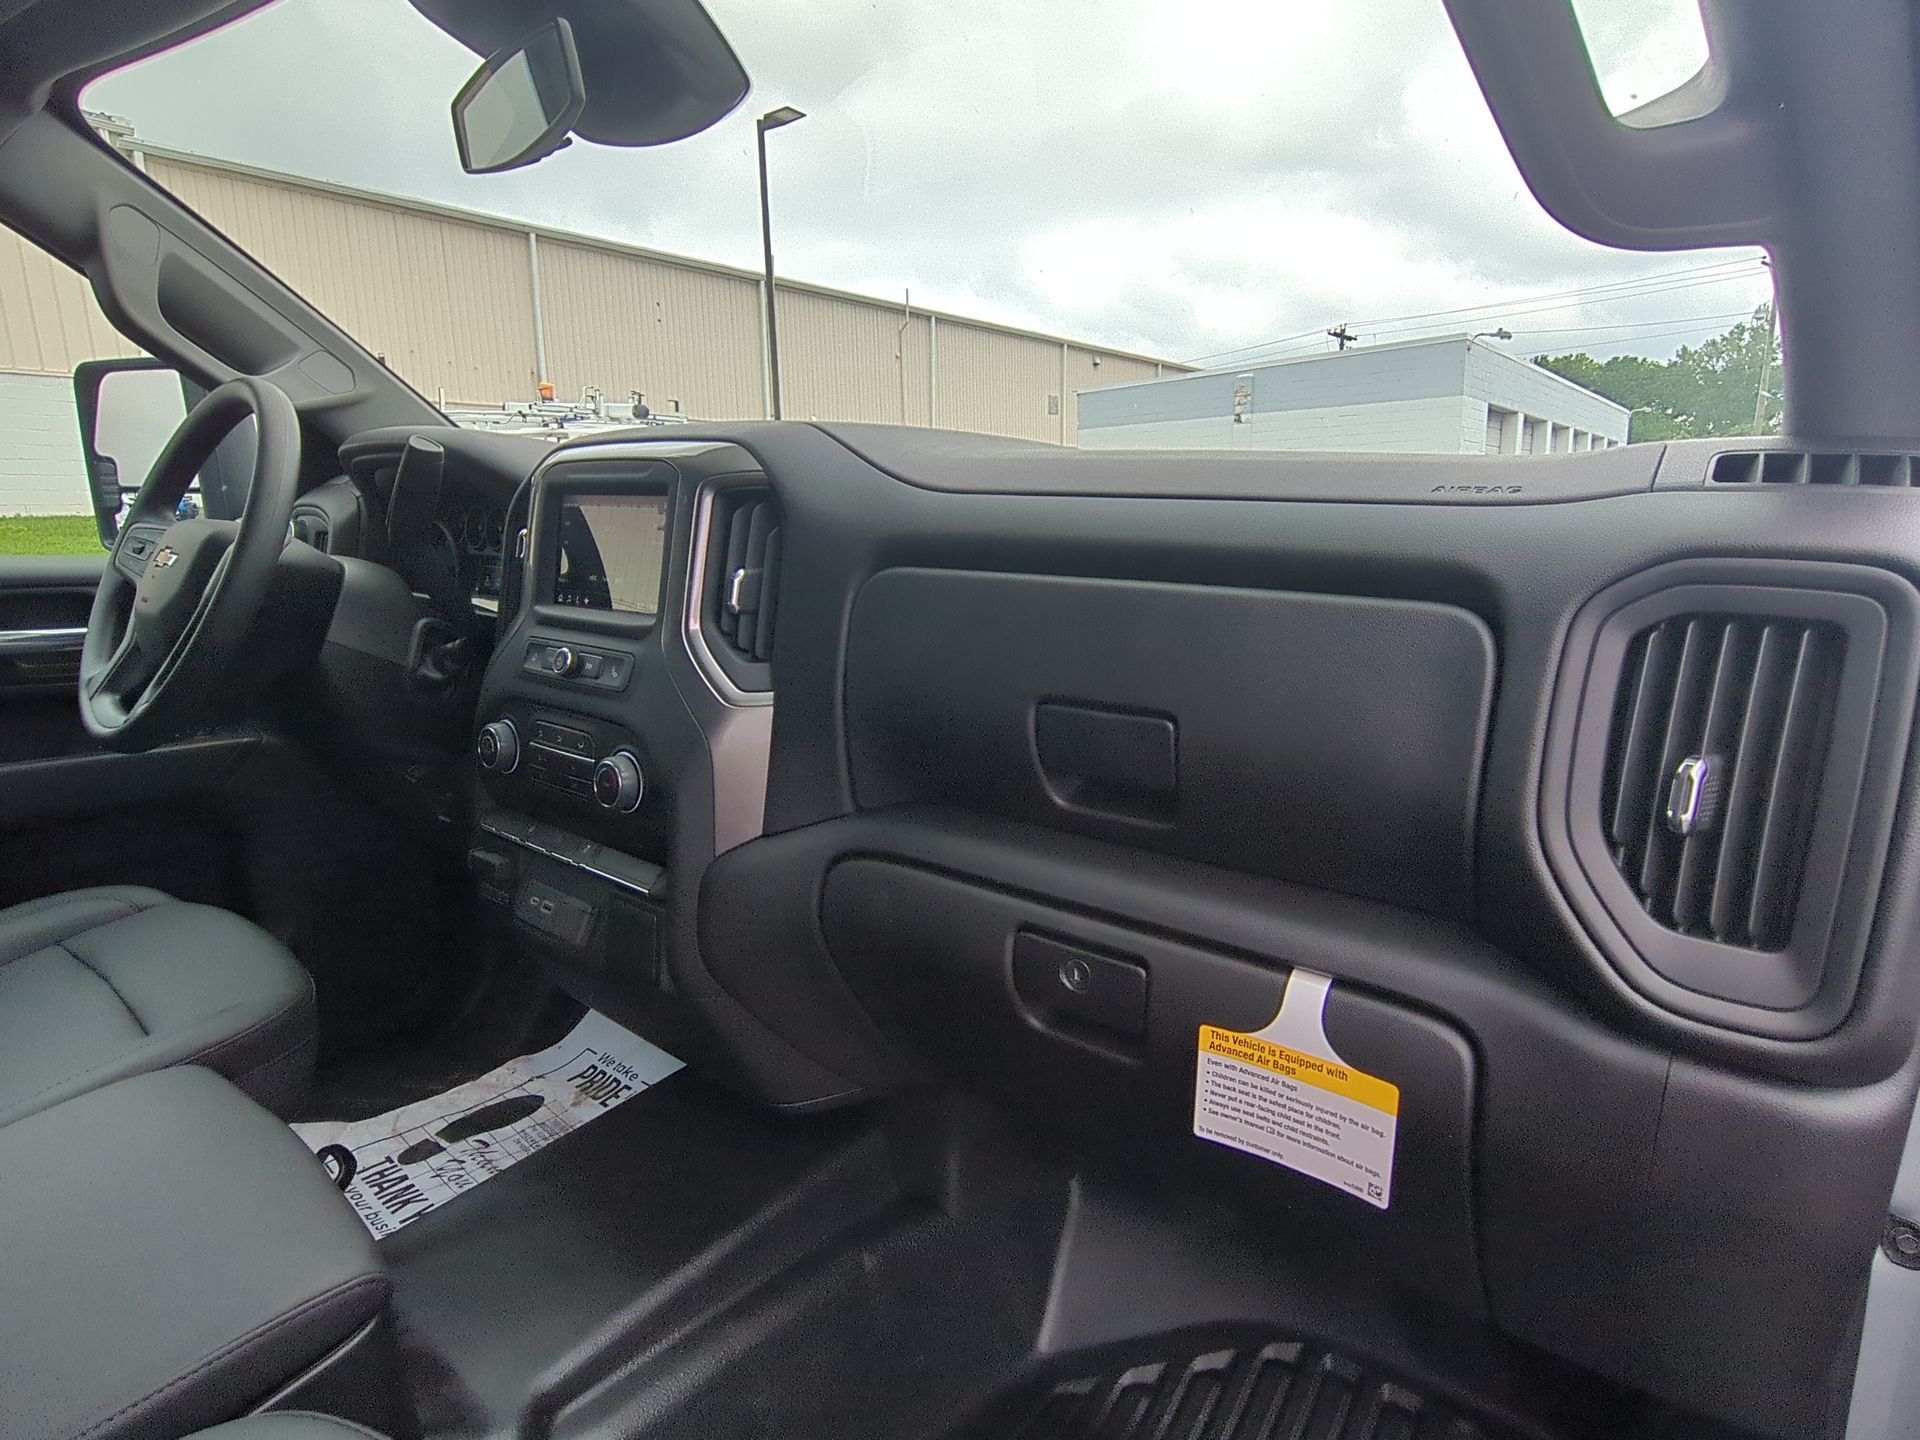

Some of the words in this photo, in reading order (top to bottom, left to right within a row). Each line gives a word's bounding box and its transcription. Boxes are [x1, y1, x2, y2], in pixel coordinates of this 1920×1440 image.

[1431, 485, 1523, 494] AIRBAG
[598, 1052, 615, 1067] We
[612, 1061, 639, 1081] take
[1207, 1058, 1222, 1068] Even
[1224, 1062, 1238, 1072] with
[1239, 1066, 1269, 1082] Advanced
[1271, 1077, 1280, 1085] Air
[1281, 1080, 1298, 1092] Bags
[1209, 1041, 1254, 1061] Advanced
[1256, 1055, 1271, 1066] Air
[1272, 1060, 1296, 1076] Bags
[1210, 1029, 1230, 1043] This
[1232, 1035, 1266, 1054] Vehicle
[1268, 1045, 1277, 1057] is
[1279, 1050, 1324, 1073] Equipped
[1326, 1066, 1348, 1081] with
[566, 1064, 633, 1108] PRIDE
[1211, 1070, 1237, 1084] Children
[1238, 1079, 1249, 1087] can
[1250, 1081, 1258, 1090] be
[1259, 1084, 1276, 1095] killed
[1286, 1094, 1314, 1110] seriously
[1315, 1105, 1338, 1118] injured
[1339, 1113, 1347, 1123] by
[1348, 1117, 1359, 1127] the
[1360, 1123, 1369, 1131] air
[1371, 1126, 1386, 1138] bag.
[1211, 1080, 1221, 1089] The
[1222, 1083, 1236, 1093] back
[1238, 1088, 1250, 1097] seat
[1258, 1094, 1267, 1103] the
[1268, 1098, 1286, 1110] safest
[1287, 1104, 1304, 1116] place
[1305, 1111, 1314, 1119] for
[1315, 1116, 1341, 1130] children.
[1208, 1099, 1229, 1111] Always
[1230, 1106, 1241, 1114] use
[1242, 1109, 1255, 1118] seat
[1256, 1113, 1270, 1124] belts
[1271, 1119, 1282, 1128] and
[1283, 1124, 1298, 1134] child
[1299, 1129, 1330, 1146] restraints.
[1210, 1089, 1227, 1099] Never
[1227, 1095, 1238, 1104] put
[1243, 1101, 1275, 1117] rear-facing
[1276, 1111, 1291, 1121] child
[1292, 1116, 1305, 1127] seat
[1313, 1124, 1323, 1133] the
[1325, 1129, 1341, 1141] front.
[1199, 1125, 1205, 1133] To
[1206, 1127, 1213, 1135] be
[1214, 1130, 1237, 1142] removed
[1238, 1137, 1245, 1146] by
[1246, 1140, 1270, 1153] customer
[1208, 1107, 1219, 1116] See
[1220, 1112, 1243, 1124] owner's
[1243, 1119, 1265, 1131] manual
[1276, 1130, 1285, 1139] for
[1285, 1134, 1301, 1145] more
[1302, 1140, 1336, 1159] information
[1337, 1154, 1354, 1166] about
[1355, 1162, 1364, 1171] air
[1364, 1166, 1381, 1179] bags.
[345, 1185, 373, 1211] your
[356, 1155, 429, 1215] THANK
